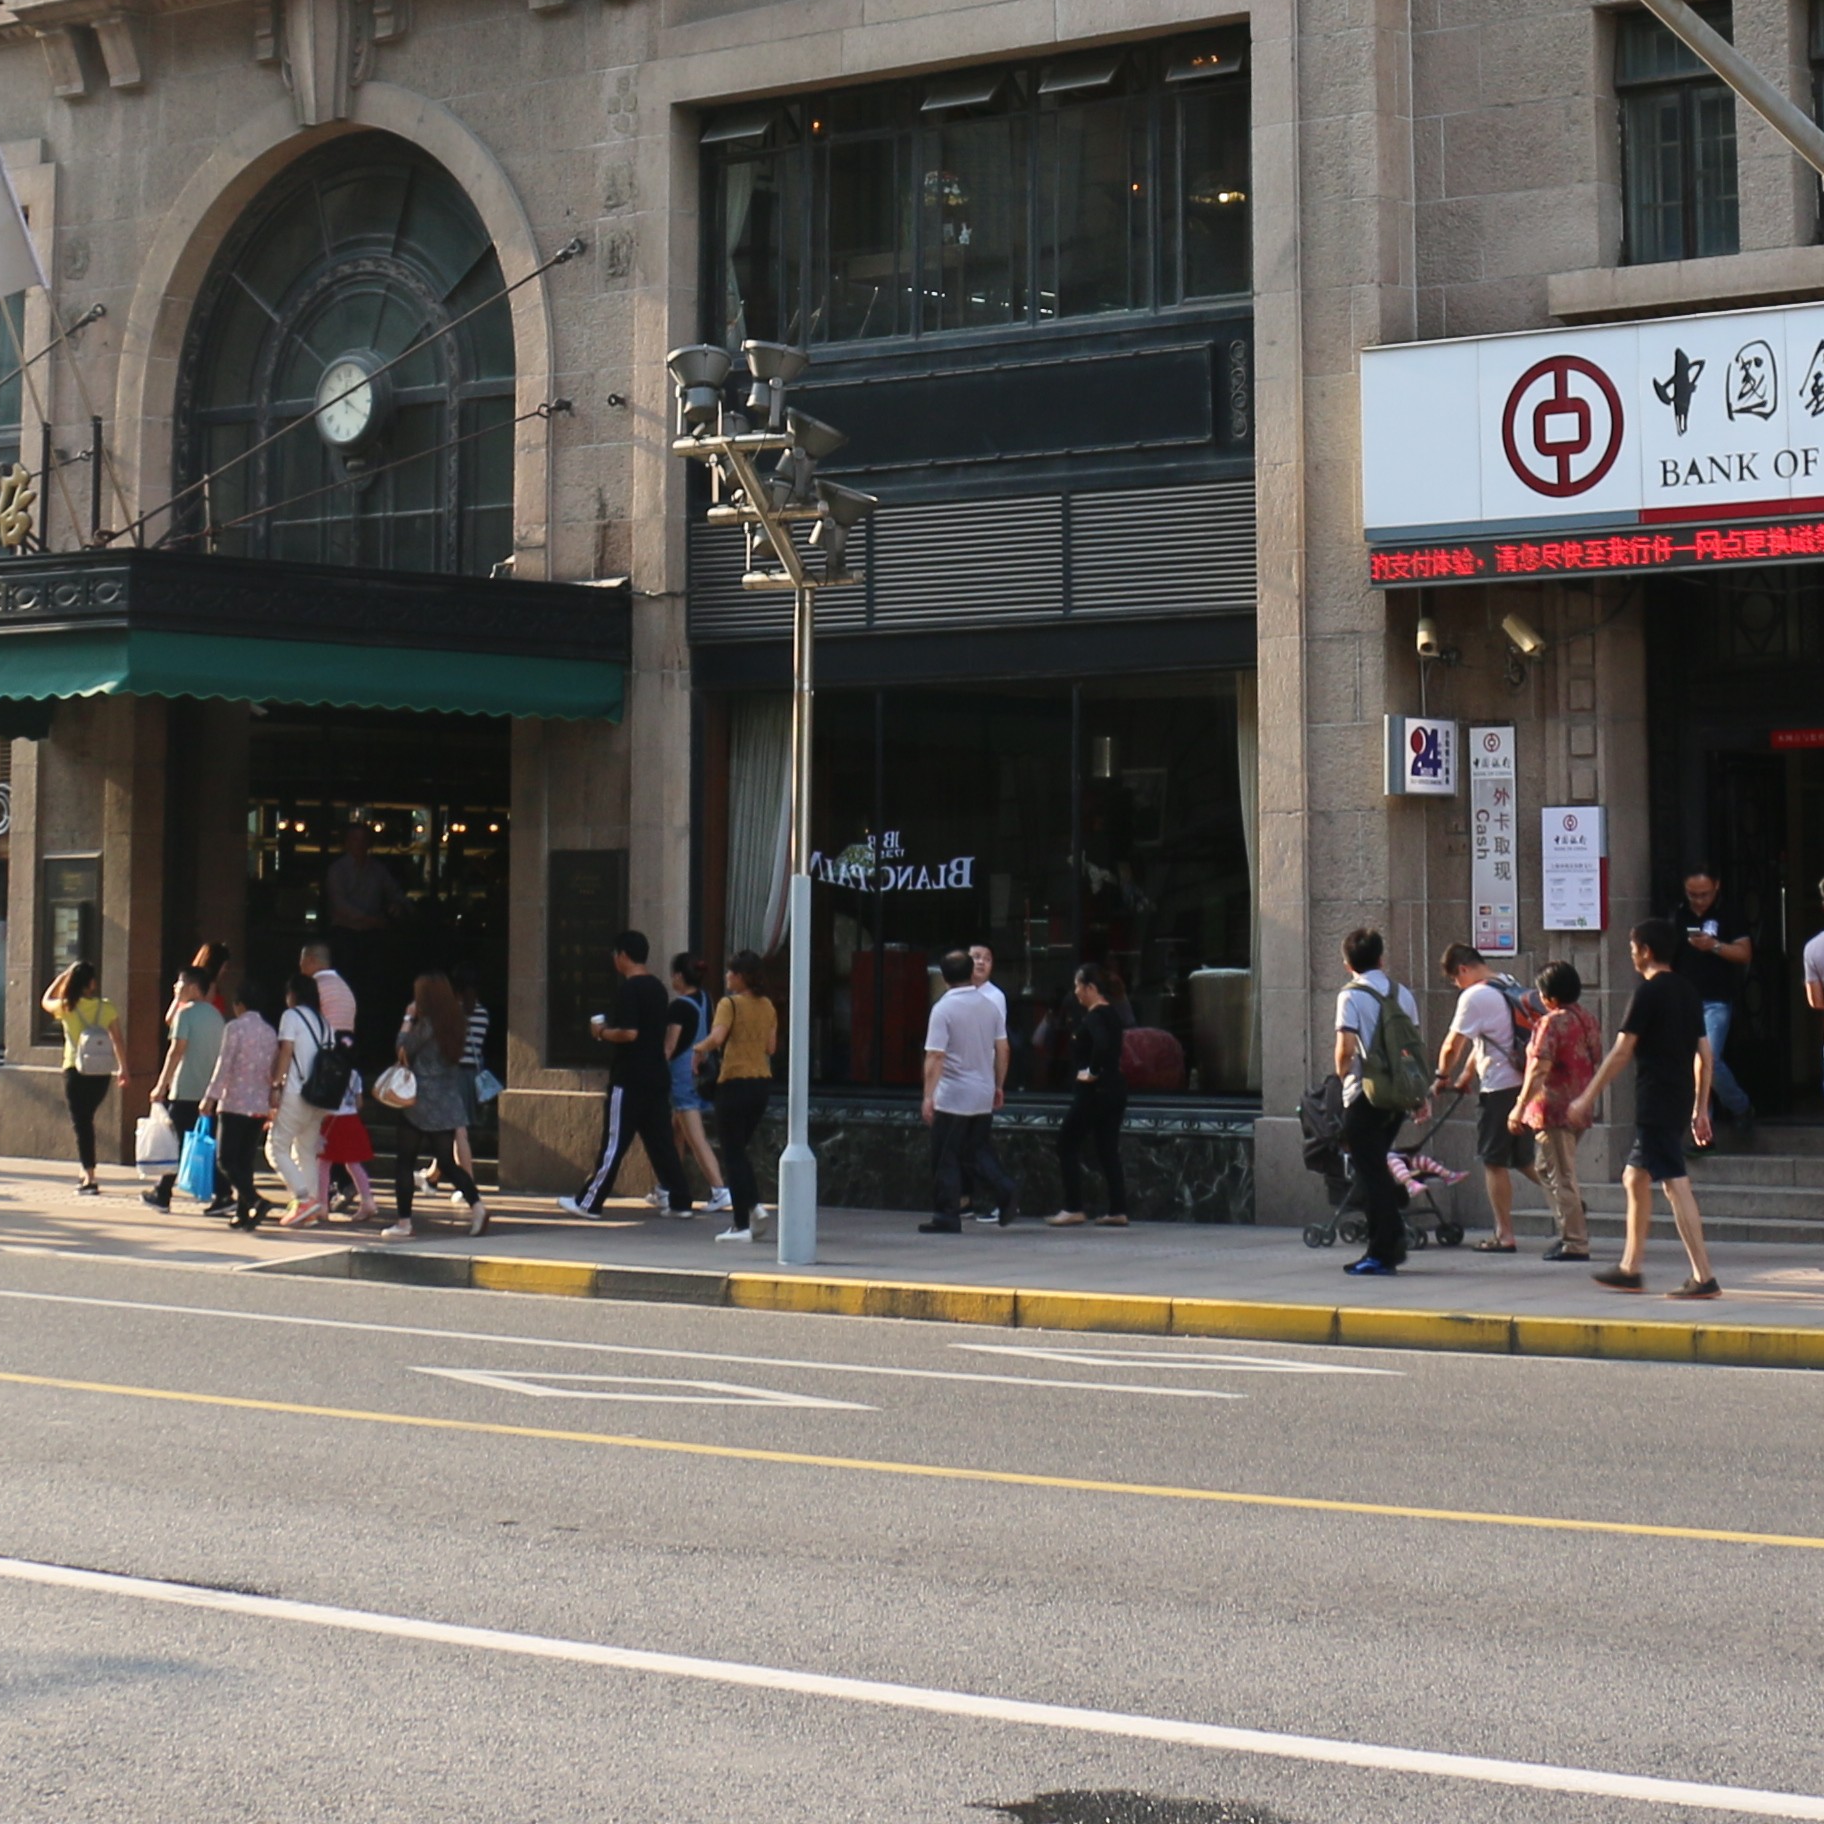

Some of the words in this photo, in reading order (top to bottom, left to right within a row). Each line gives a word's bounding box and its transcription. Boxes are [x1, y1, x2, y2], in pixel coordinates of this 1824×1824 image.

[1660, 452, 1760, 488] BANK
[1773, 447, 1820, 478] OF
[1410, 726, 1442, 777] 24
[1476, 809, 1490, 860] Cash
[1493, 787, 1511, 881] 外卡取现
